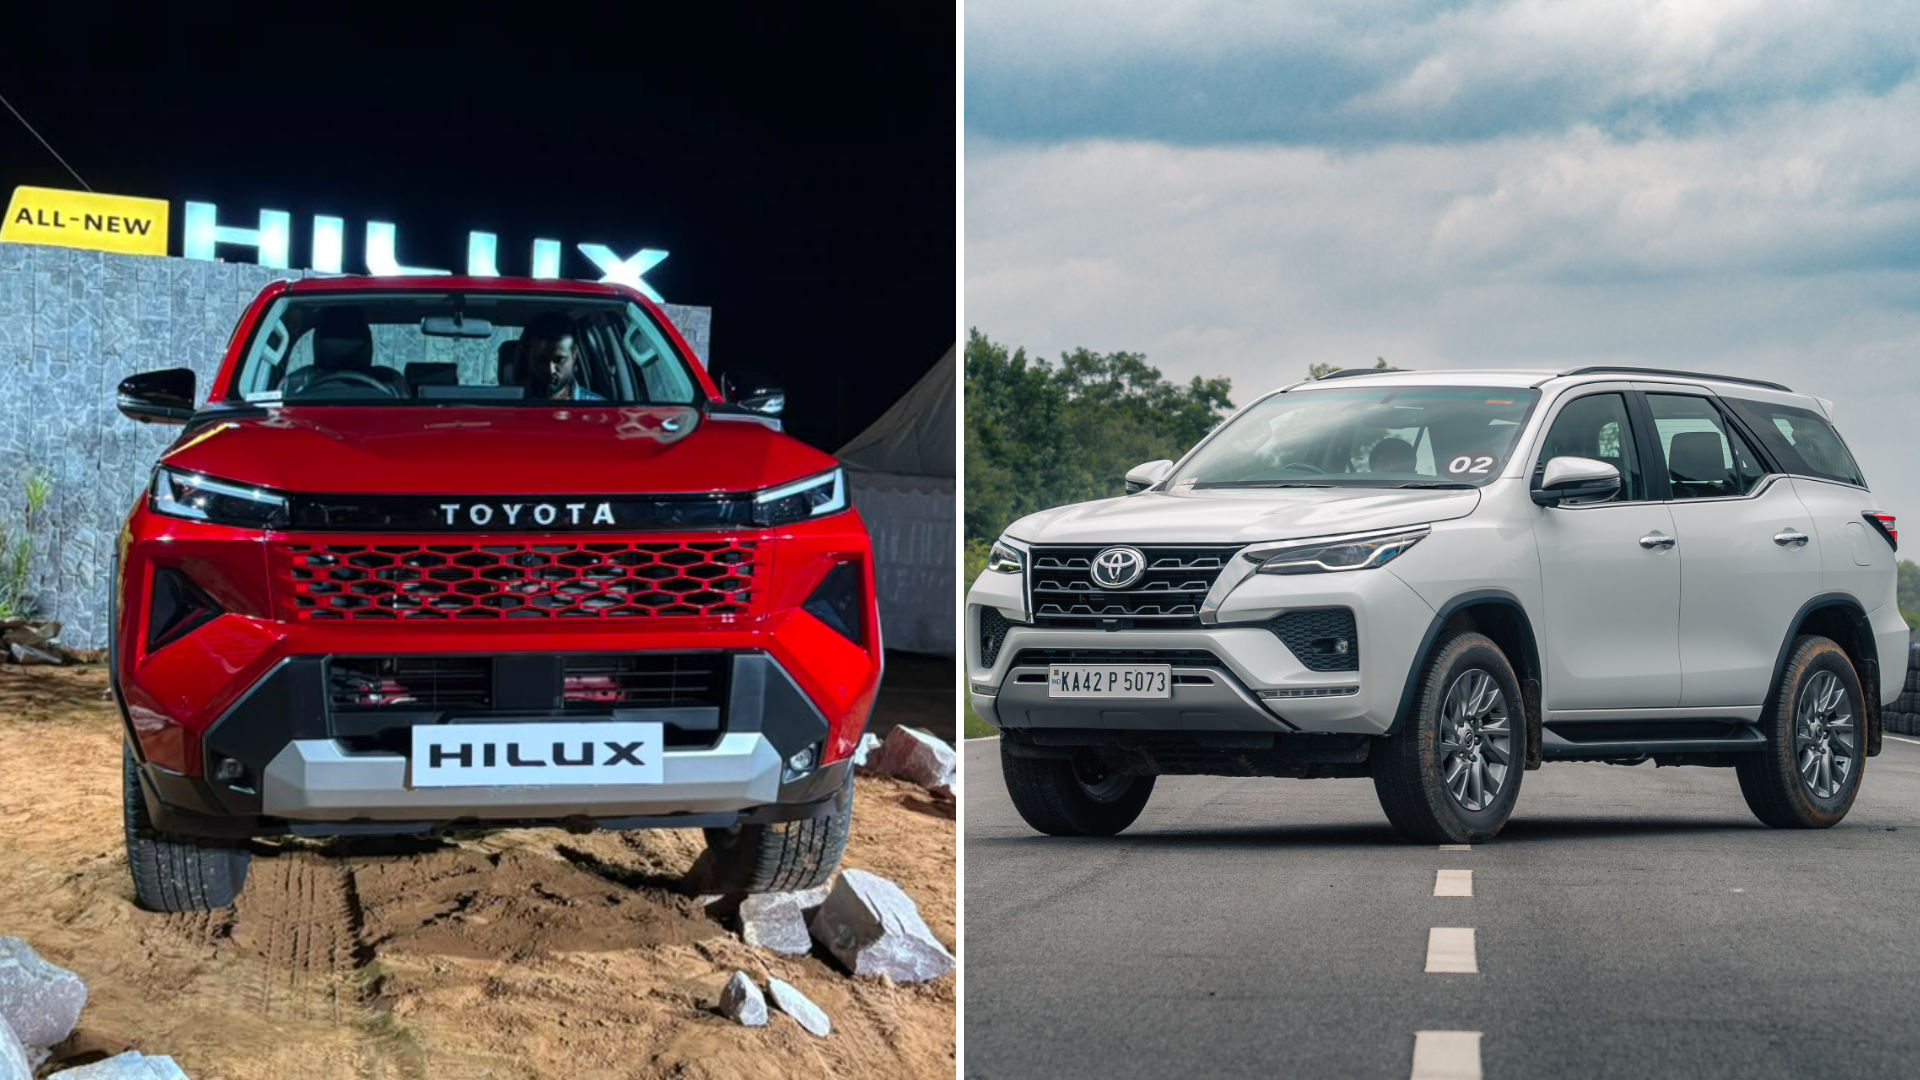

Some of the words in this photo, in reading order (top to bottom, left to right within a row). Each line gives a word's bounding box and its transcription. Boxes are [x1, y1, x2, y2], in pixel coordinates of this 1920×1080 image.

[15, 207, 152, 236] ALL-NEW
[184, 201, 670, 304] HILUX
[1448, 456, 1494, 474] 02
[440, 503, 616, 525] TOYOTA
[1061, 671, 1102, 692] KA42
[1108, 671, 1118, 692] P
[1124, 671, 1166, 692] 5073
[429, 741, 646, 768] HILUX
